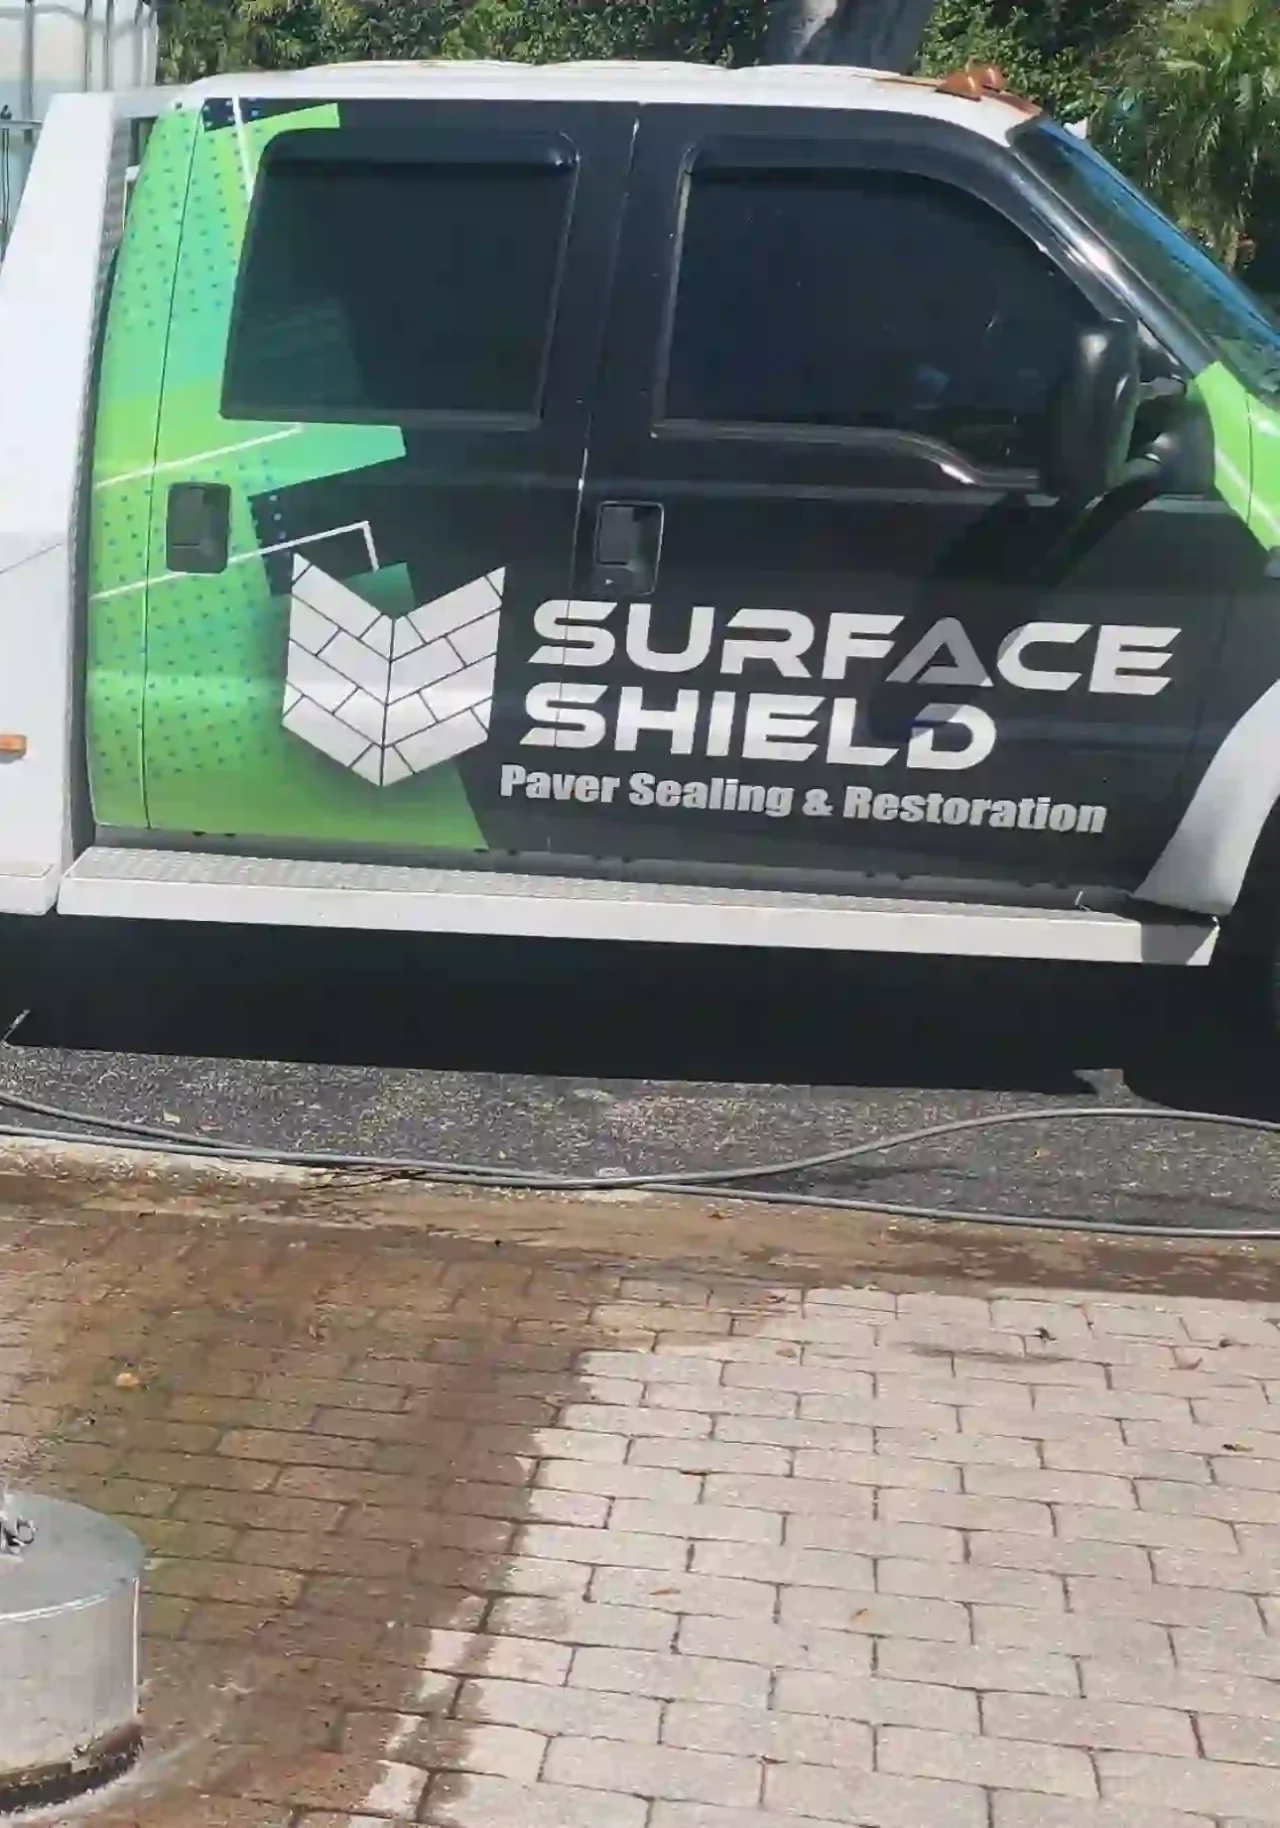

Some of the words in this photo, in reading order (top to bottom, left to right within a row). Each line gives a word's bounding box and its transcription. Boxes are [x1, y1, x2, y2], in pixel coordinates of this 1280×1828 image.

[526, 599, 1183, 696] SURFACE
[519, 681, 998, 771] SHIELD
[500, 763, 621, 804] Paver
[628, 772, 795, 819] Sealing
[802, 788, 834, 817] &
[843, 785, 1108, 834] Restoration
